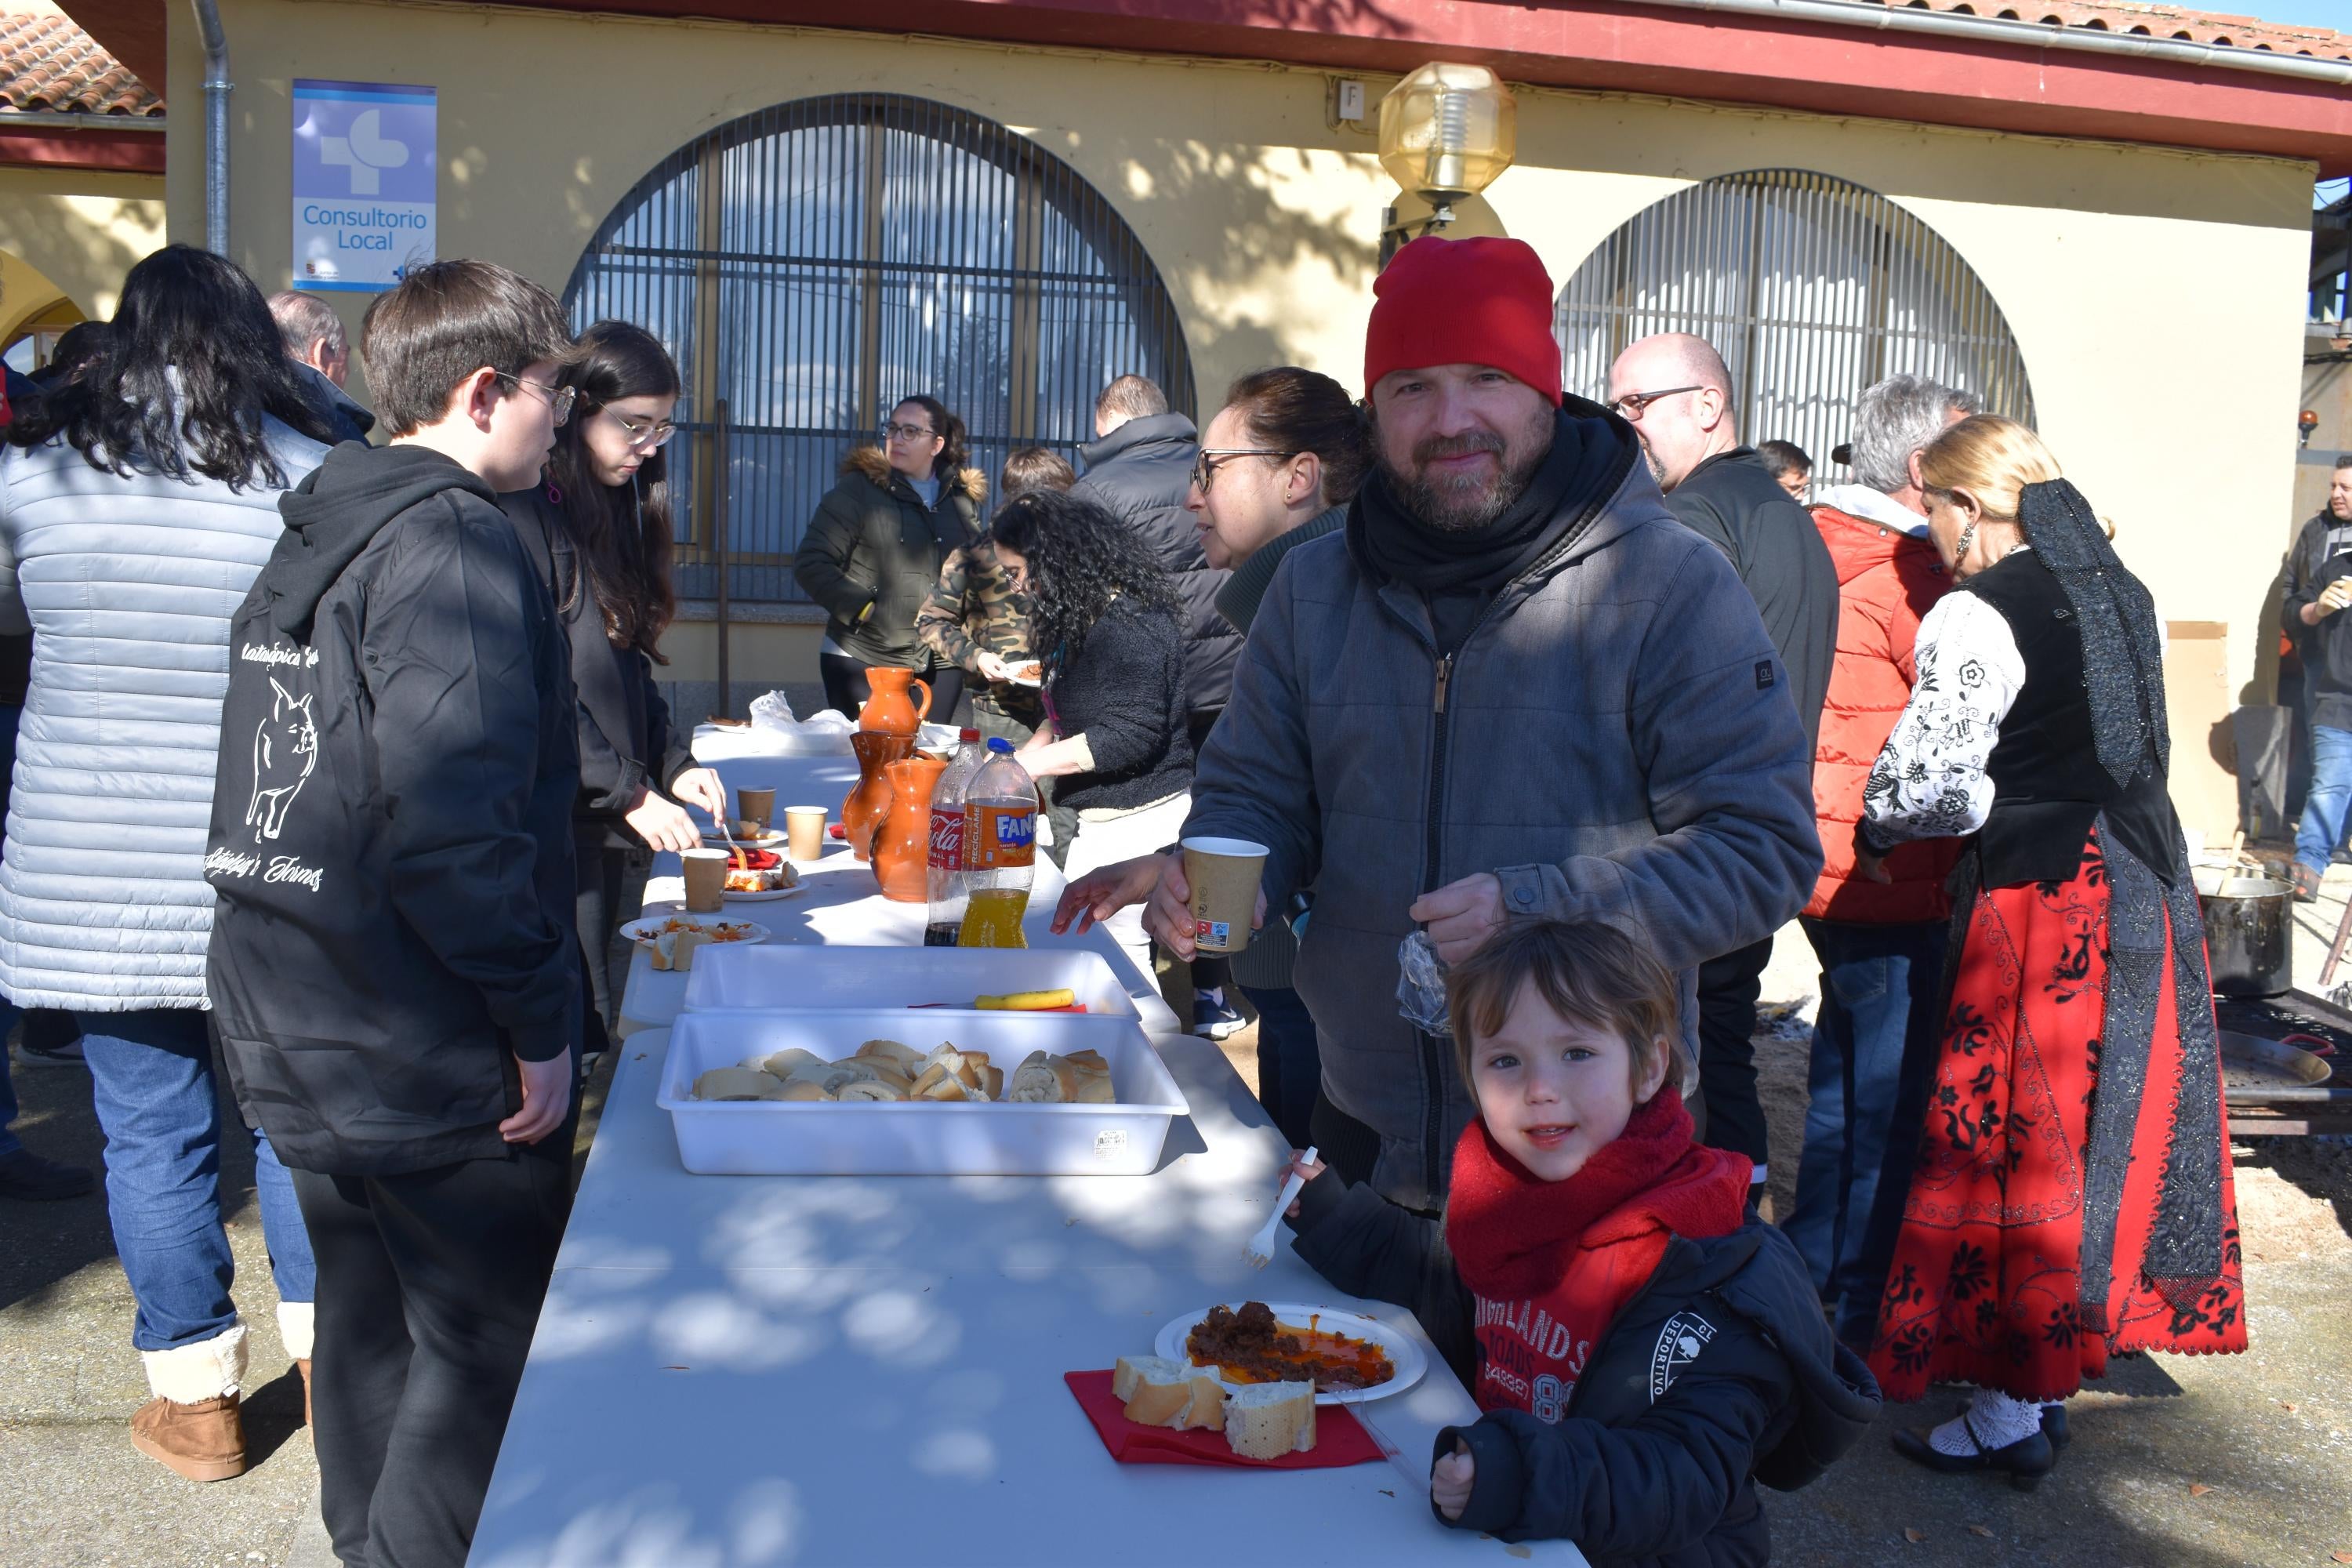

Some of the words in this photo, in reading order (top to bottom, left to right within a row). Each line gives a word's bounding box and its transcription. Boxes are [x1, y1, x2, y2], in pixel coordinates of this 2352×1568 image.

[303, 205, 426, 229] Consultorio
[338, 230, 393, 250] Local
[1654, 1320, 1681, 1395] DEPORTIVO
